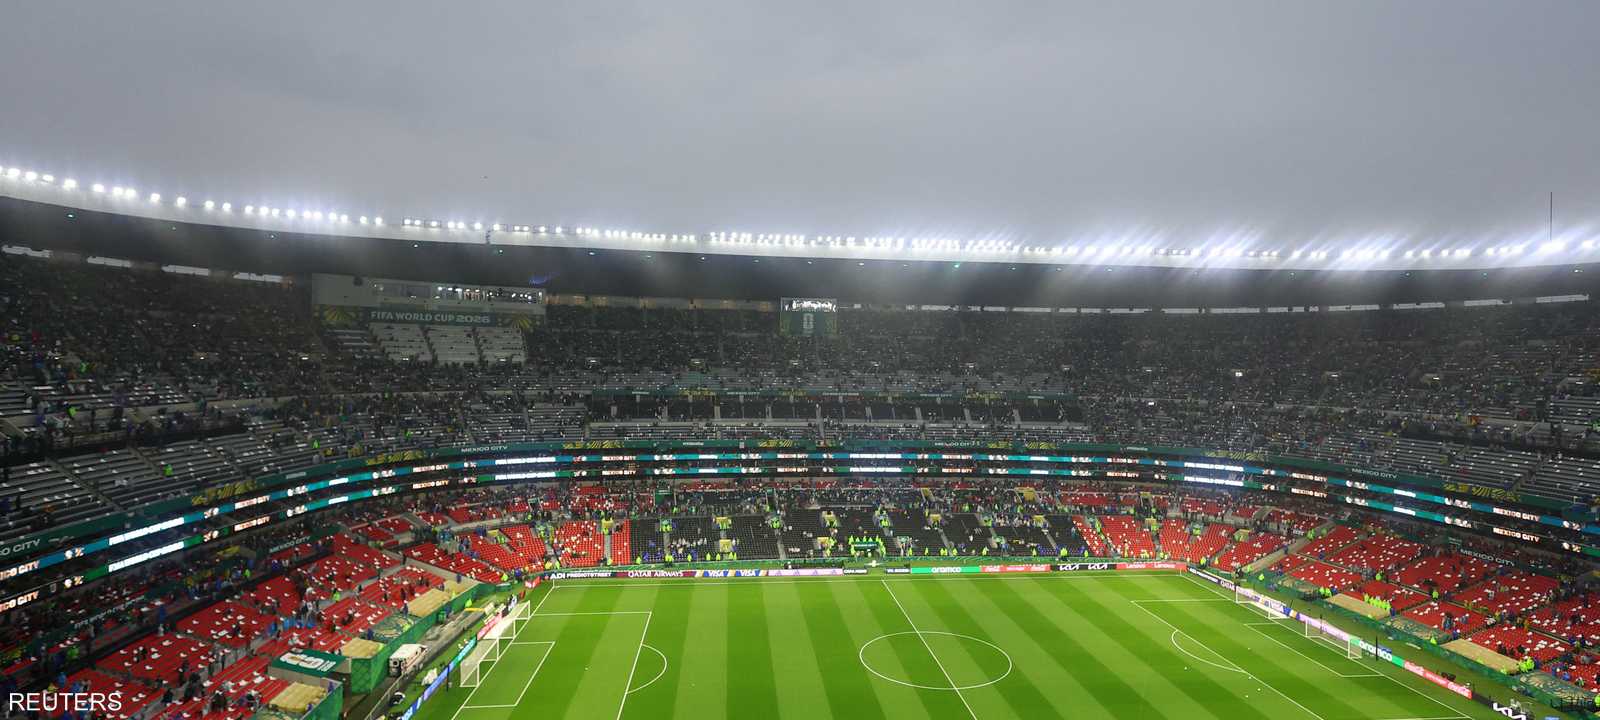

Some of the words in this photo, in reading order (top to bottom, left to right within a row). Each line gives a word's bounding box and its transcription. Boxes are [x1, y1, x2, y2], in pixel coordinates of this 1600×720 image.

[371, 311, 393, 320] FIFA
[395, 312, 432, 321] WORLD
[434, 314, 454, 322] CUP
[456, 315, 490, 323] 2026
[1351, 467, 1379, 476] MEXICO
[1492, 507, 1521, 519] MEXICO
[1522, 512, 1540, 522] CITY
[1492, 527, 1521, 539] MEXICO
[1522, 532, 1540, 543] CITY
[13, 538, 41, 553] CITY
[1460, 548, 1494, 561] MEXICO
[18, 559, 40, 574] CITY
[628, 570, 652, 578] QATAR
[708, 570, 725, 578] VISA
[740, 569, 757, 577] VISA
[17, 590, 40, 606] CITY
[1359, 640, 1393, 662] aramco
